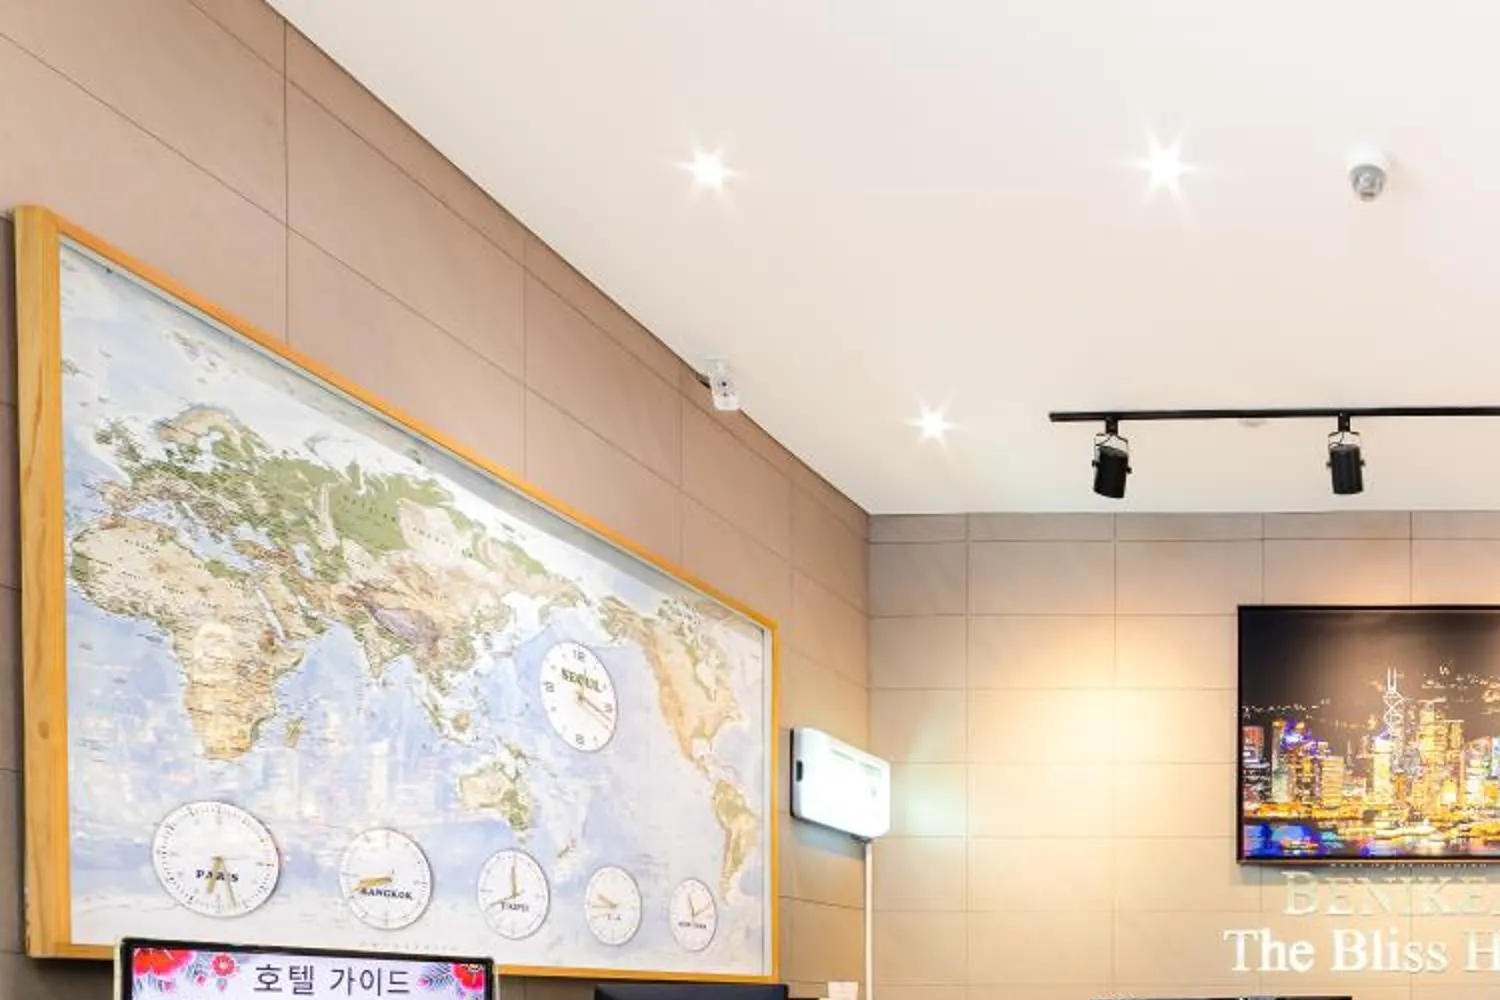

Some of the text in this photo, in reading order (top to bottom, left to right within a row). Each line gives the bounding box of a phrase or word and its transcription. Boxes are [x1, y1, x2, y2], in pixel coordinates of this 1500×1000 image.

[1224, 928, 1315, 972] The
[1329, 927, 1447, 973] Bliss
[254, 963, 411, 997] 호텔 가이드
